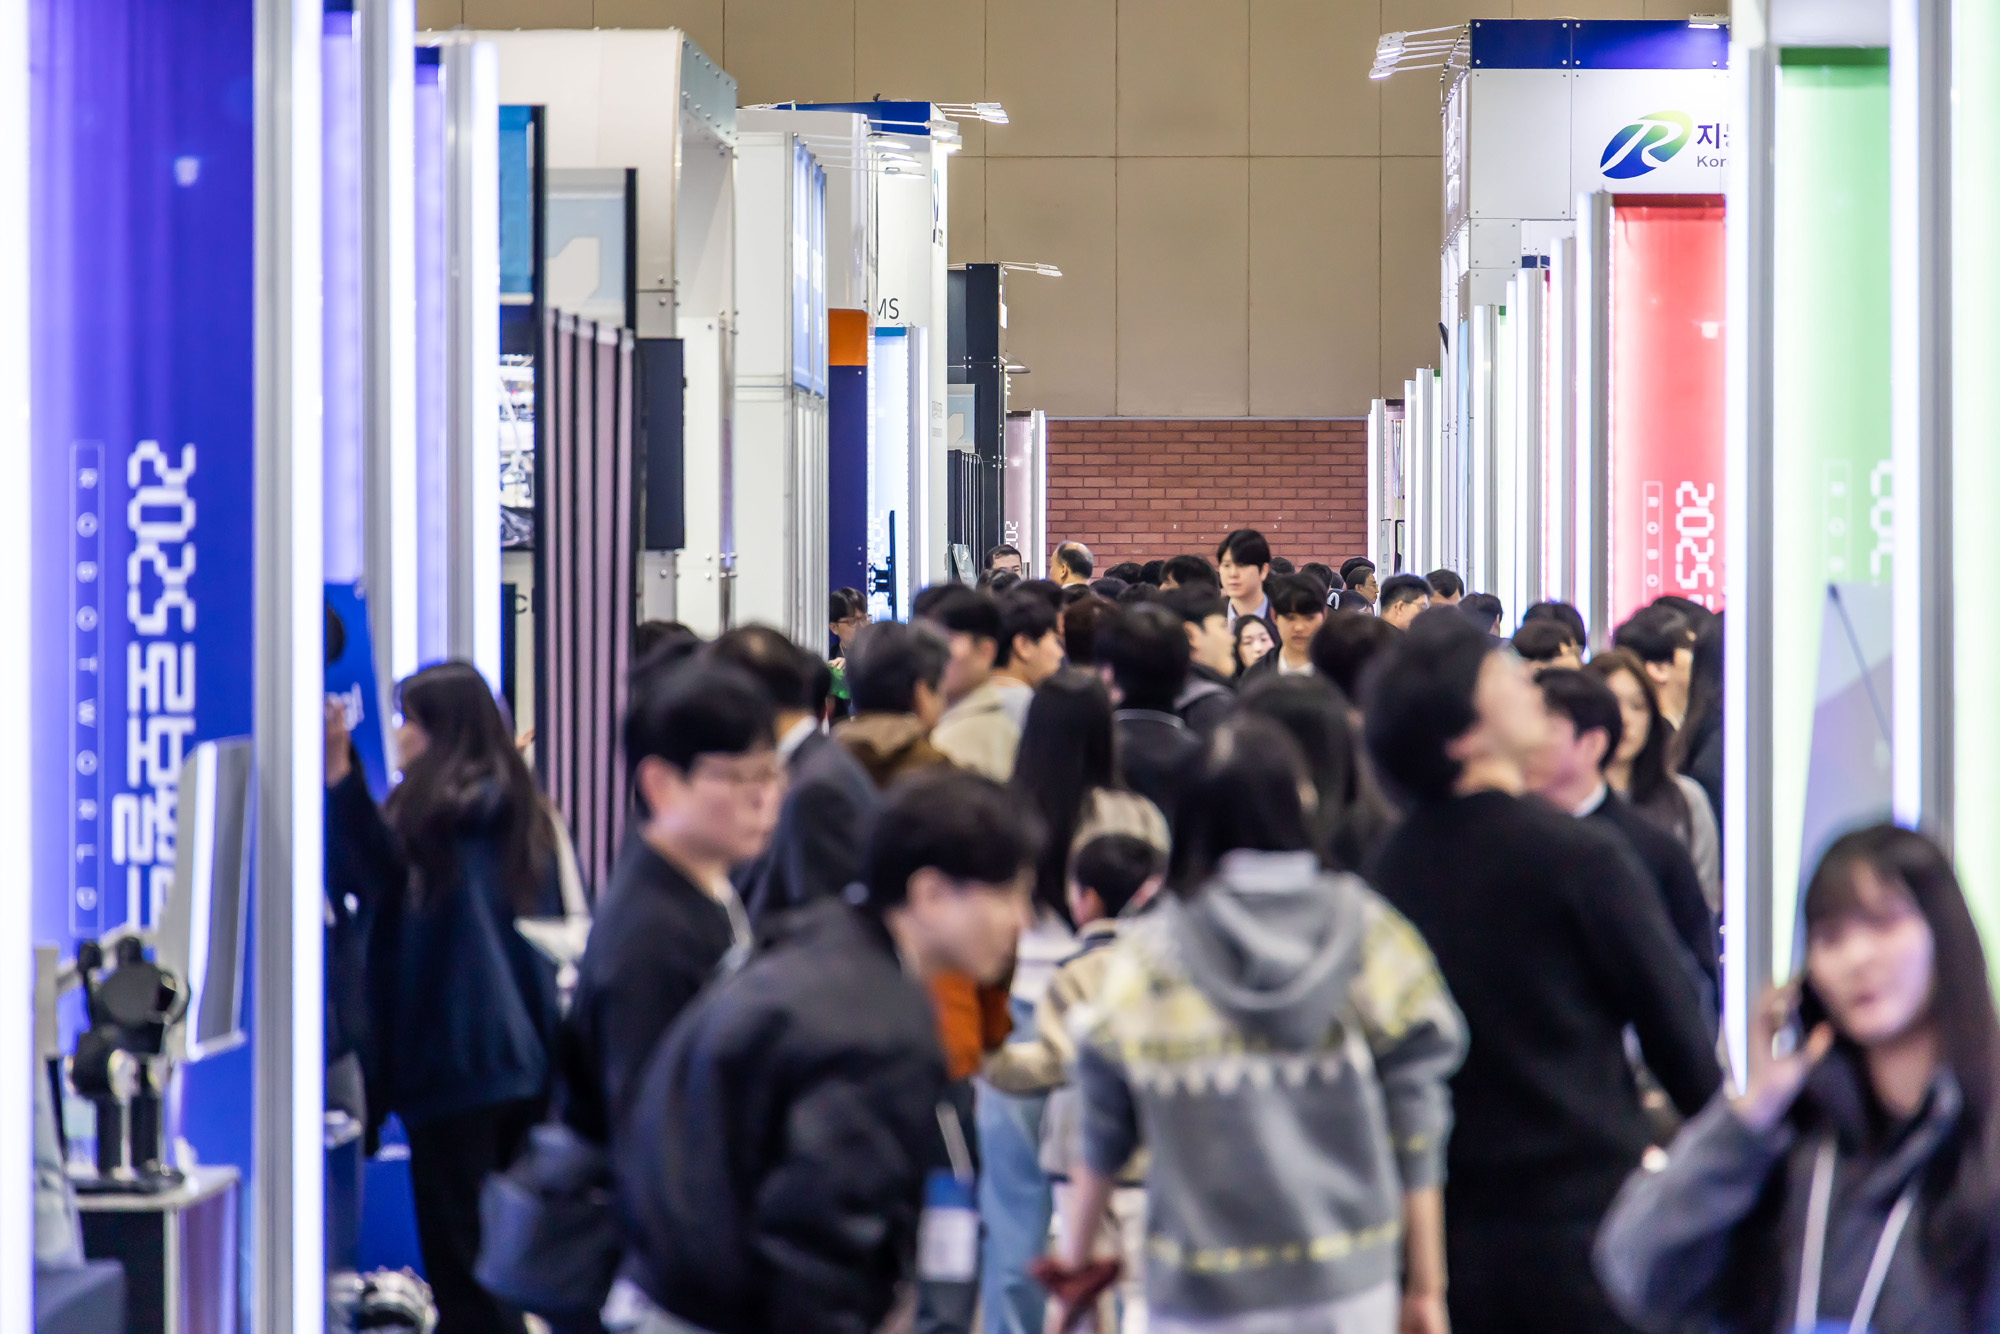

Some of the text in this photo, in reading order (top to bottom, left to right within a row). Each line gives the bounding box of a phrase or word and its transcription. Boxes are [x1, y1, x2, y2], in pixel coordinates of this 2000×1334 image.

[1697, 122, 1729, 149] 지
[1697, 155, 1728, 168] Kor
[127, 440, 196, 636] 2025
[1675, 481, 1714, 590] 2025
